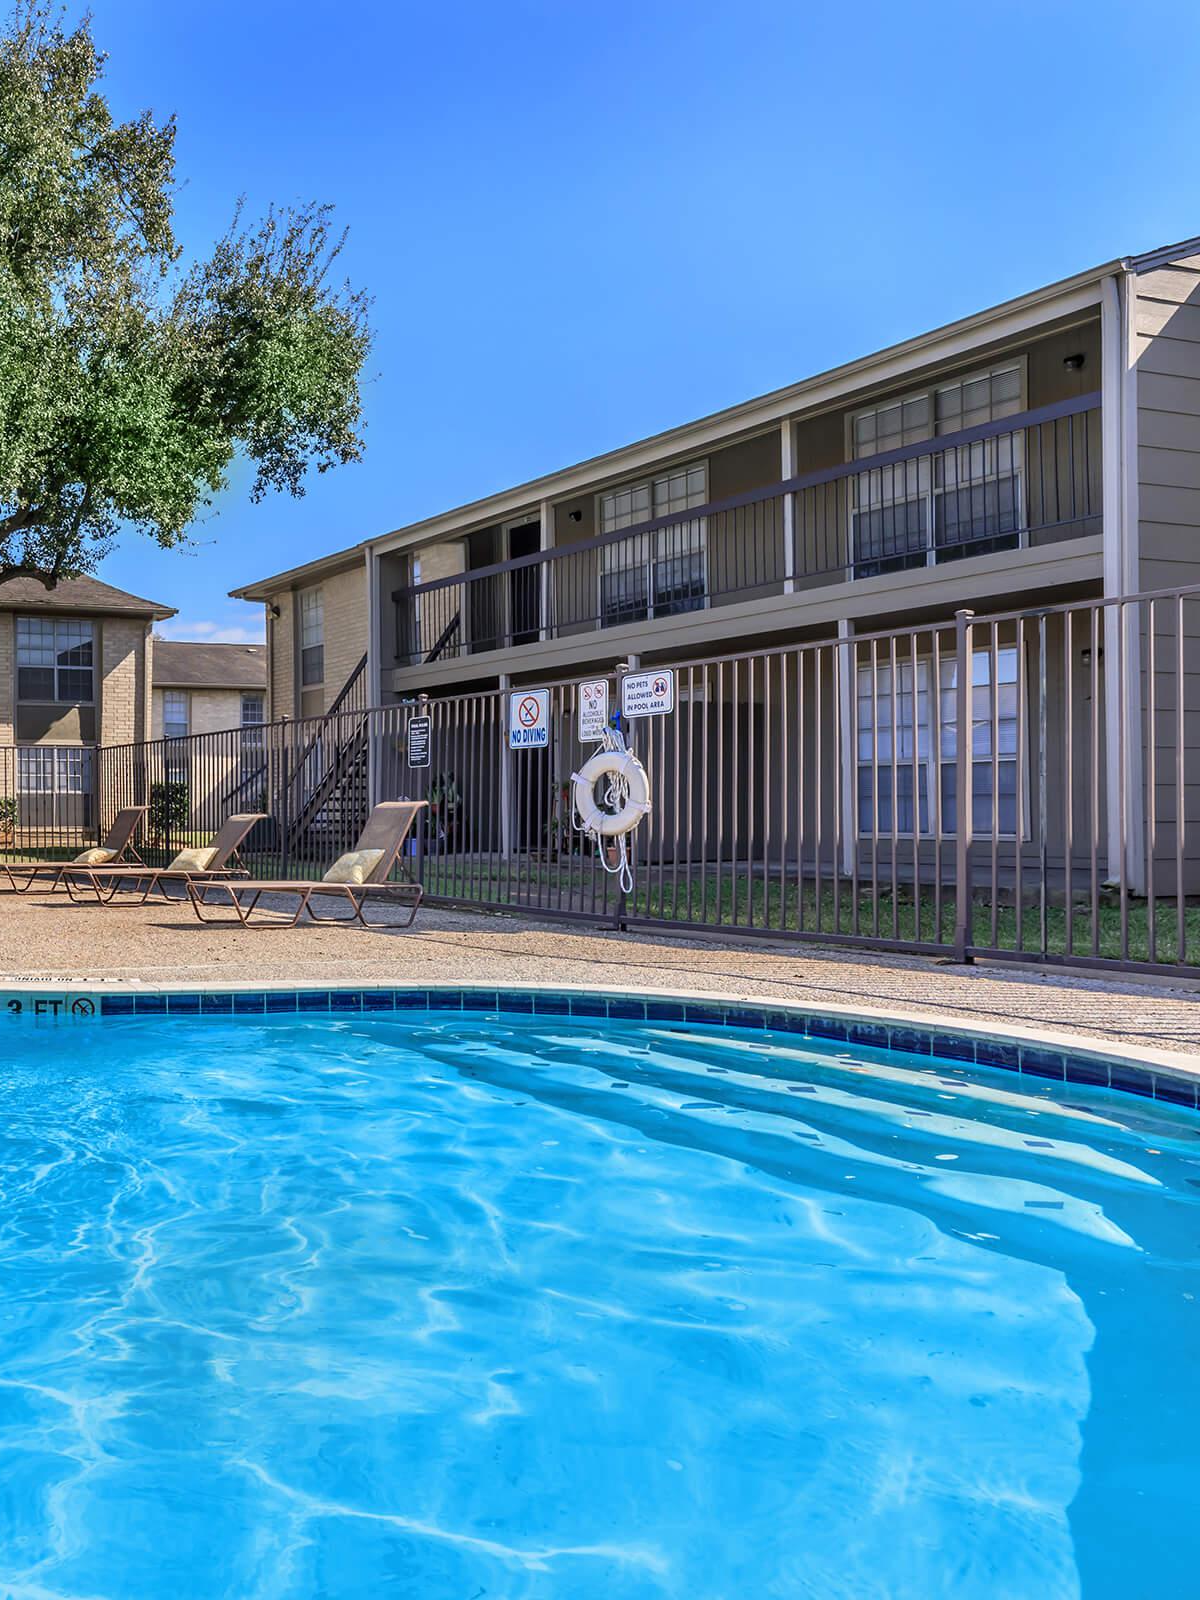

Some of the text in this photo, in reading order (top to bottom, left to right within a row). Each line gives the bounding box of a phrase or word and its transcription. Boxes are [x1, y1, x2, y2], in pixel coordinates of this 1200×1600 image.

[627, 682, 636, 690] NO
[627, 691, 653, 700] ALLOWED
[588, 699, 598, 710] NO
[633, 702, 649, 710] POOL
[650, 700, 665, 708] AREA
[511, 727, 546, 744] NO DIVING
[7, 999, 63, 1015] 3 FT
